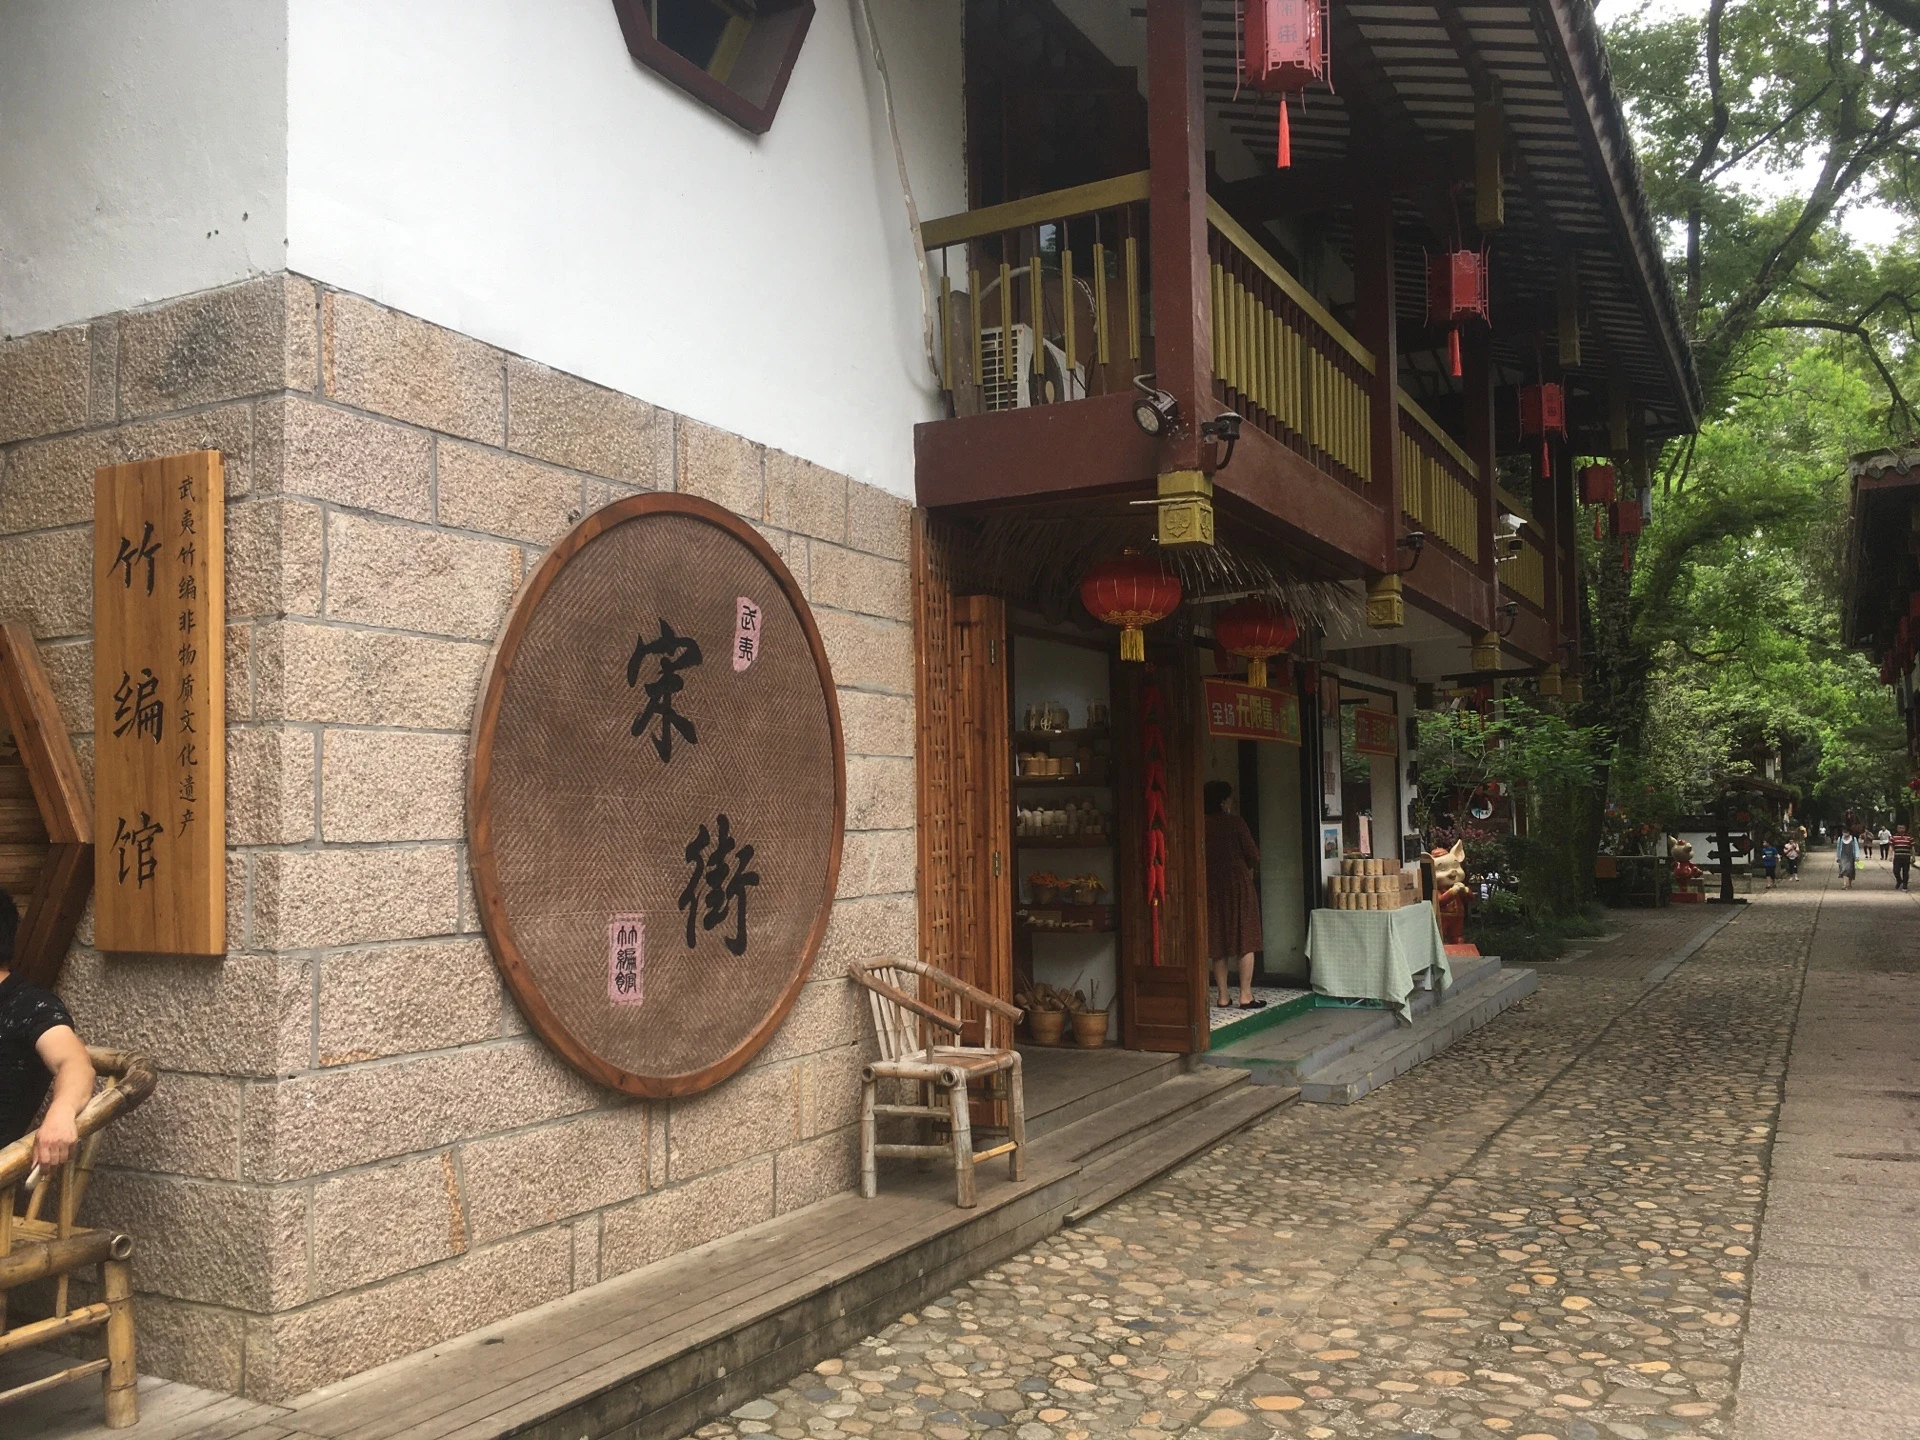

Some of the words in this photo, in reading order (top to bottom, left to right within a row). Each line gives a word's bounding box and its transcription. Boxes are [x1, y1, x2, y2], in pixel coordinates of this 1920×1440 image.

[106, 520, 165, 890] 竹编馆
[176, 474, 199, 839] 武夷竹编非物质文化遗产
[626, 616, 760, 957] 宋街
[738, 605, 757, 662] 武夷
